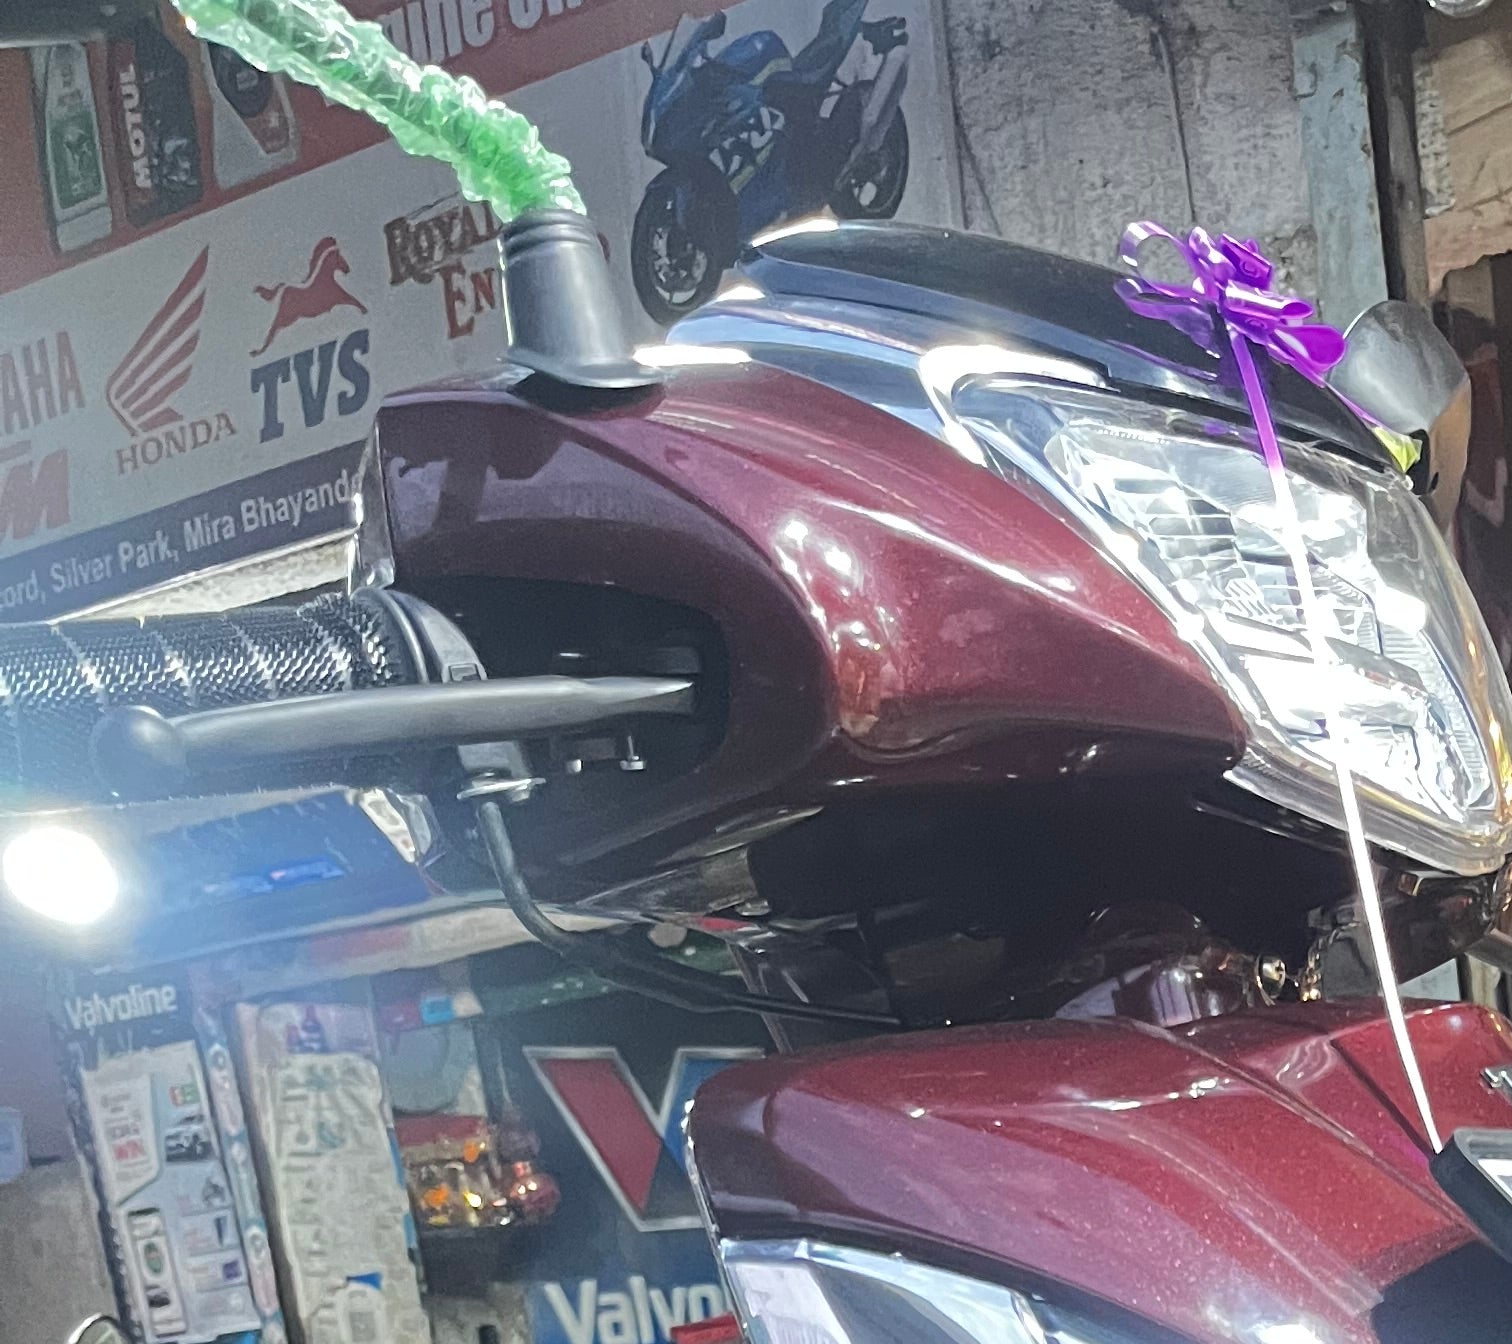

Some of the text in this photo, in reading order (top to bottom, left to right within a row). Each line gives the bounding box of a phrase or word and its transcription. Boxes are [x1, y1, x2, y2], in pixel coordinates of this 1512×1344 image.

[119, 63, 151, 188] MOTUL
[0, 330, 86, 436] AHA
[251, 328, 370, 443] TVS
[115, 411, 238, 477] HONDA
[51, 553, 113, 594] Silver
[118, 529, 180, 575] Park,
[183, 513, 236, 553] Mira
[64, 983, 179, 1031] Valvoline
